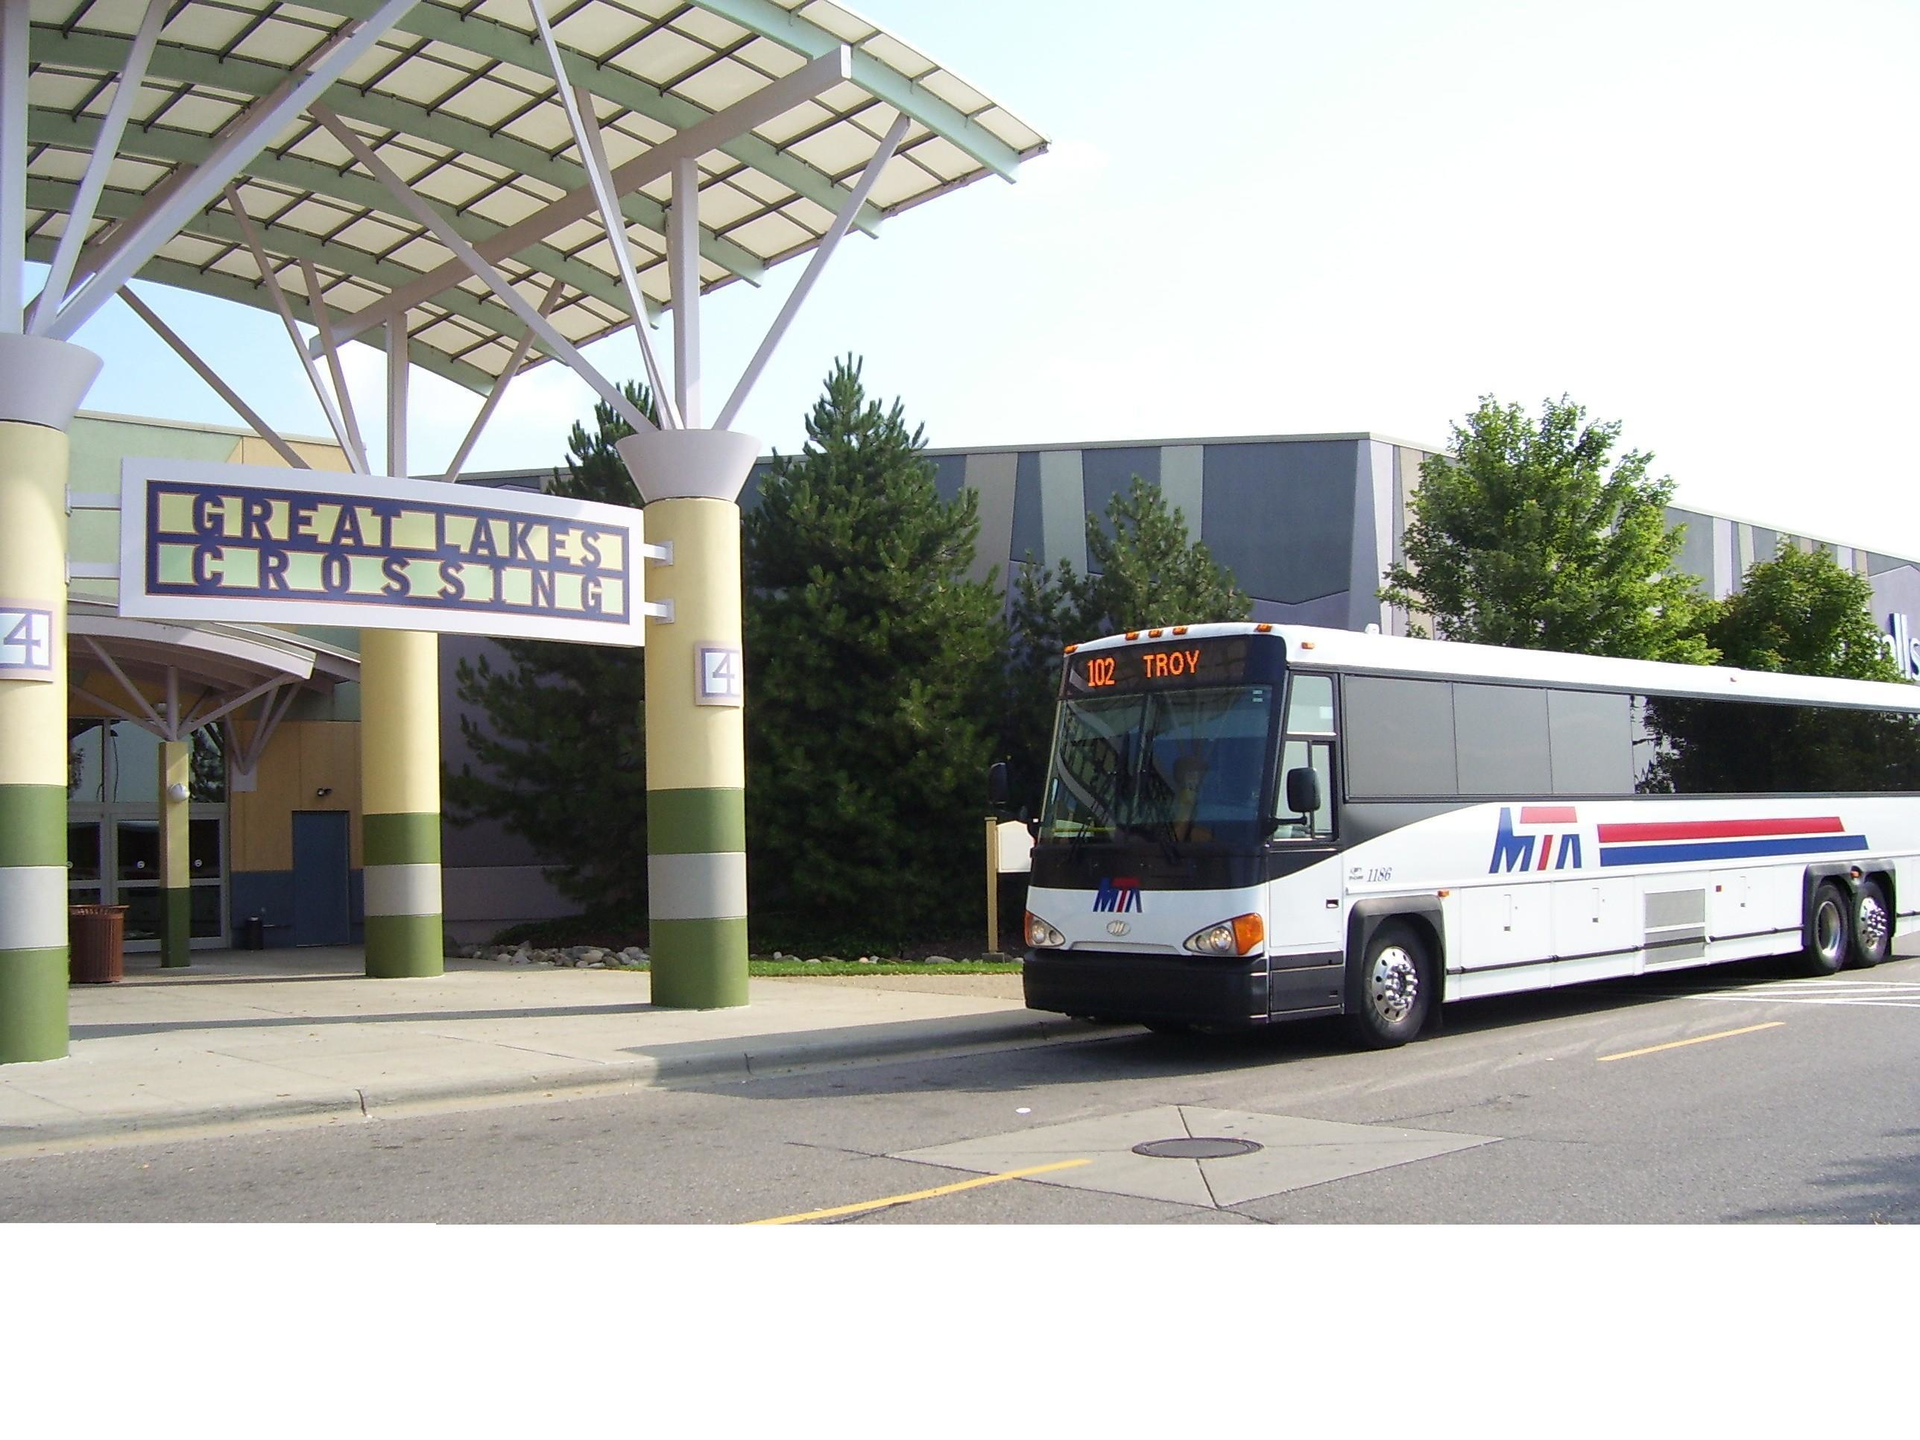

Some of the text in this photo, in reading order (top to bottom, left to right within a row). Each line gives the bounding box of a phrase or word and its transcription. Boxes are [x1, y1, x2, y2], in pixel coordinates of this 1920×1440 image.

[192, 491, 602, 569] GREAT LAKES
[191, 542, 604, 614] CROSSING
[3, 611, 42, 668] 4
[1087, 649, 1200, 687] 102 TROY
[712, 651, 736, 696] 4
[1488, 806, 1583, 874] MTA
[1367, 866, 1393, 882] 1186
